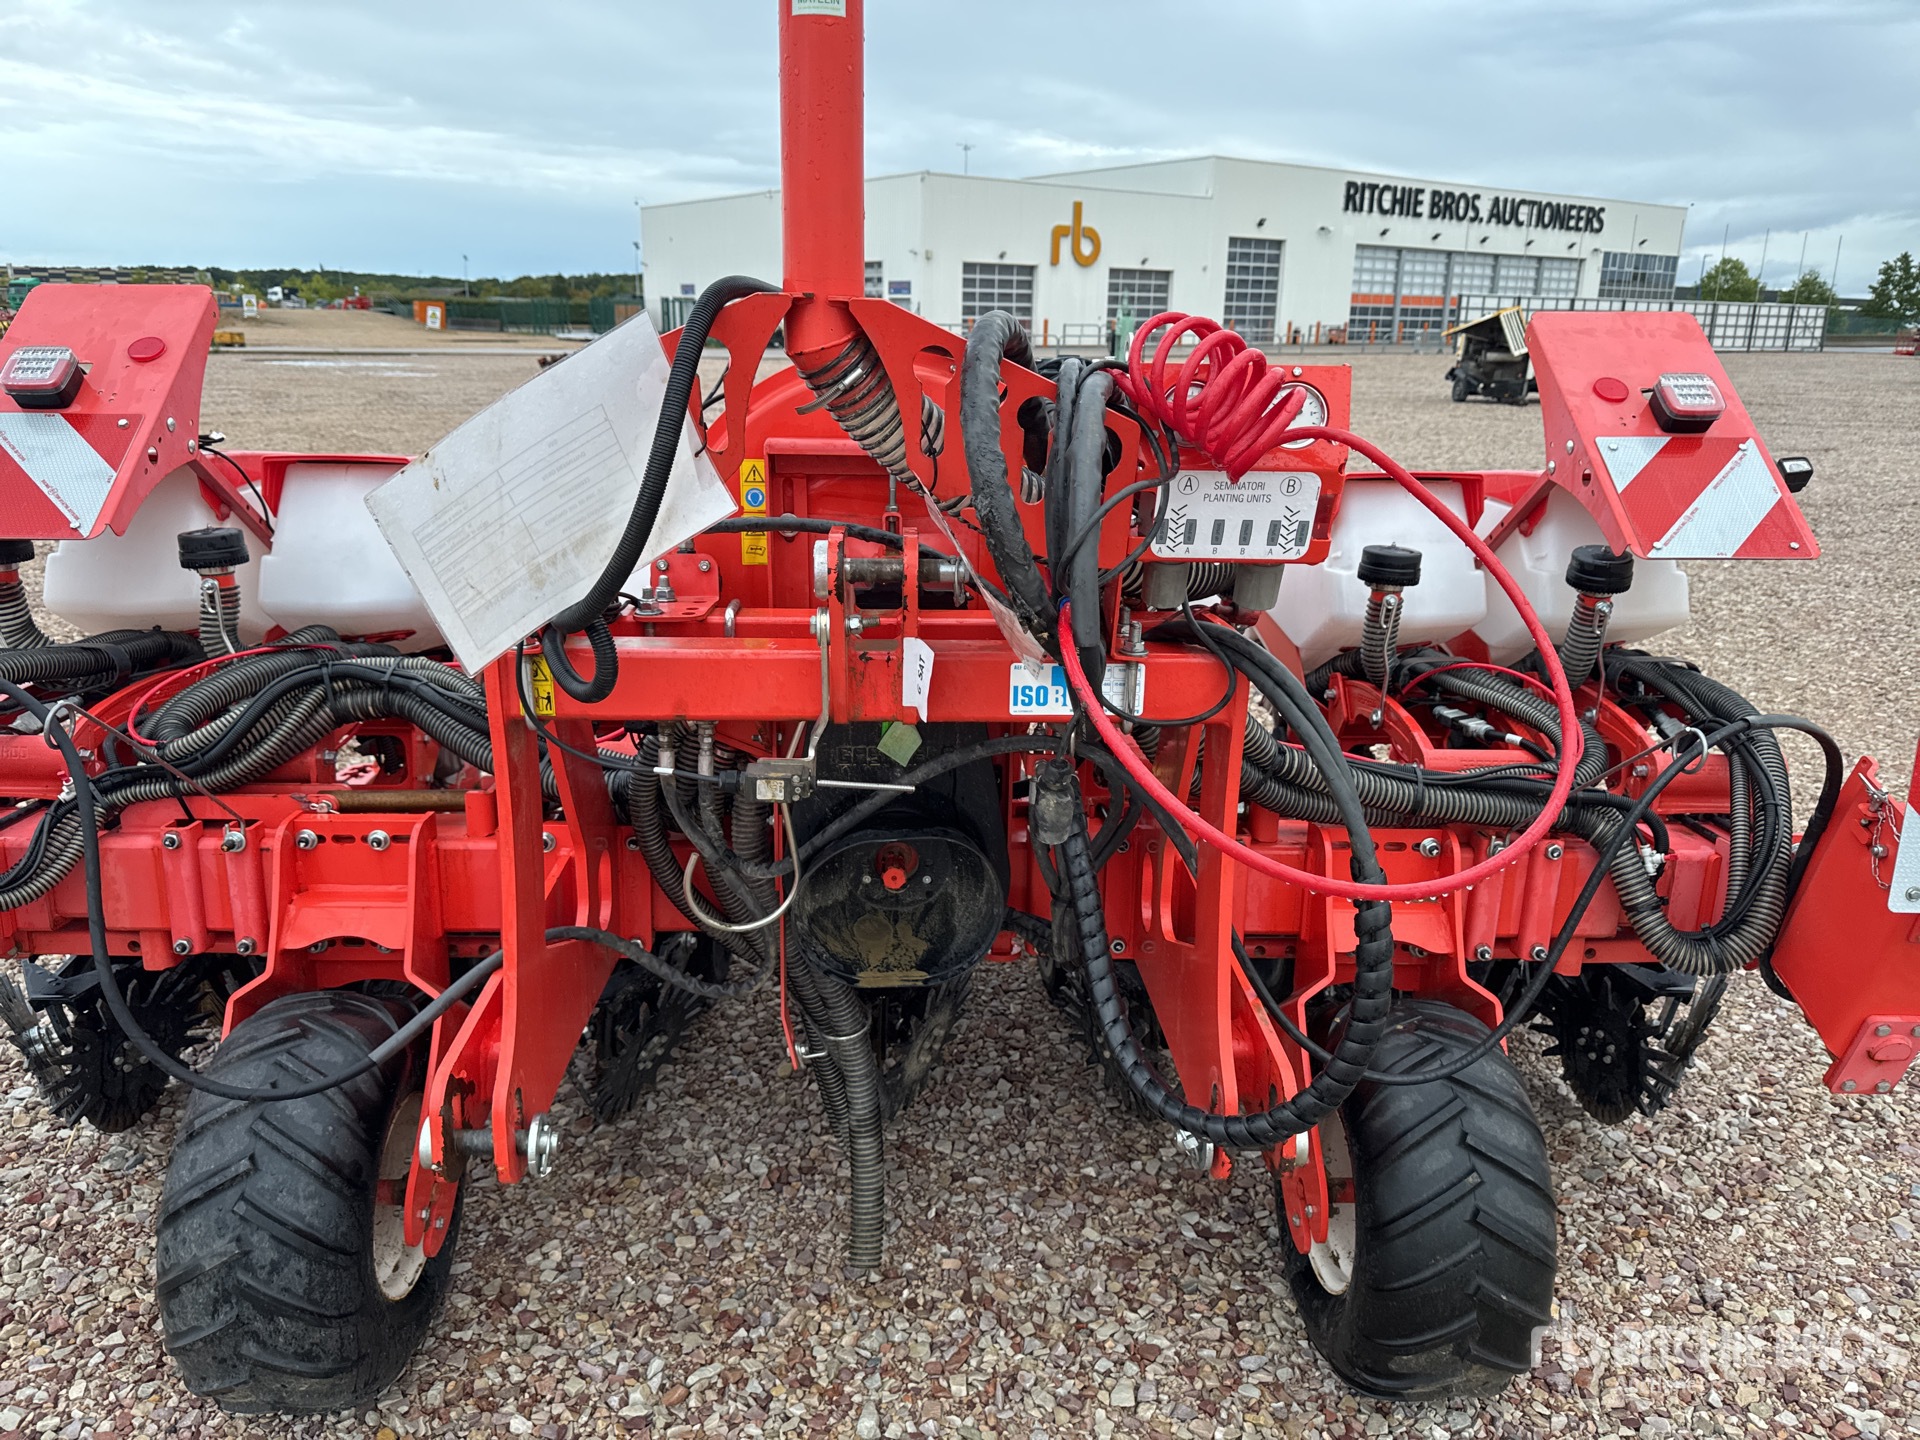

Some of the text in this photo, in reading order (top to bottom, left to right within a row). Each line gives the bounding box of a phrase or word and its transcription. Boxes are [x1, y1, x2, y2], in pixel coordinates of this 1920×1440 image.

[1343, 181, 1606, 234] RITCHIE BROS. AUCTIONEERS
[1050, 200, 1102, 268] rb
[1213, 480, 1266, 491] SEMINATORI
[1203, 493, 1272, 503] PLANTING UNITS
[1239, 547, 1246, 555] B
[1267, 548, 1274, 556] A
[1012, 684, 1067, 707] ISOB
